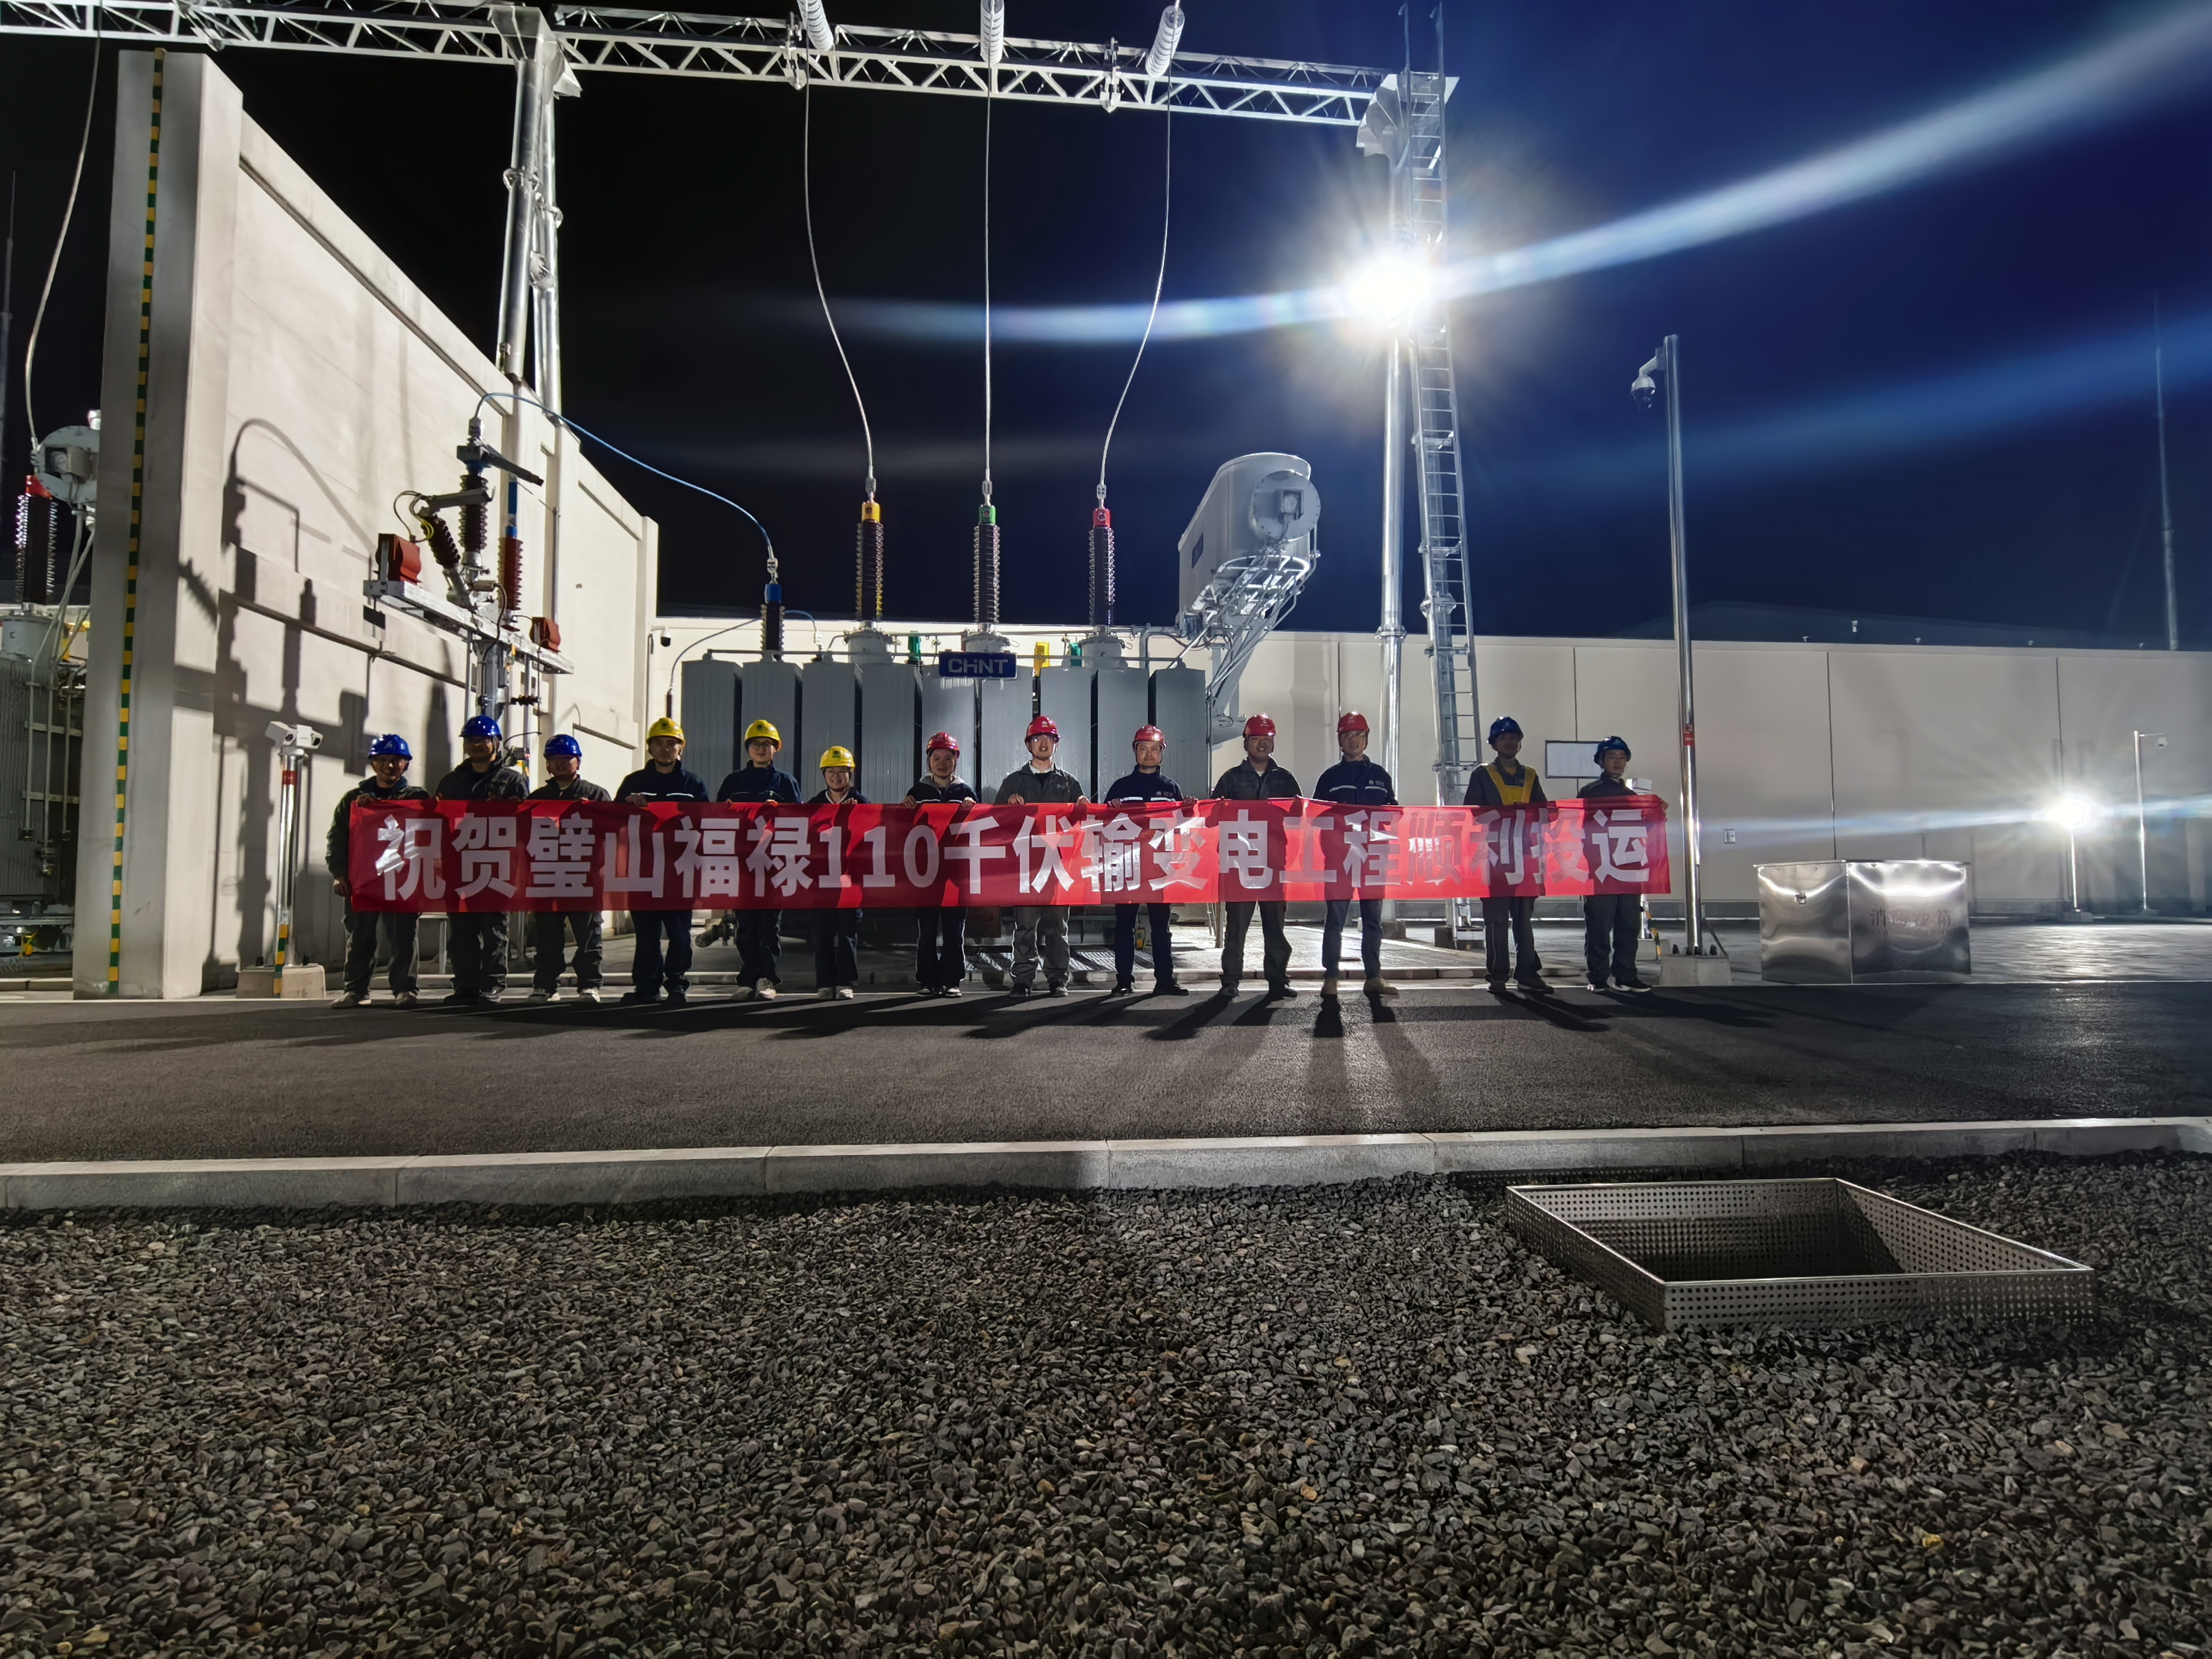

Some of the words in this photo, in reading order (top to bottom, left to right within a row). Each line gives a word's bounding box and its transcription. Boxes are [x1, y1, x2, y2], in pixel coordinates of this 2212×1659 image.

[375, 808, 1596, 901] 祝贺璧山福禄110千伏输变电工程顺利投运
